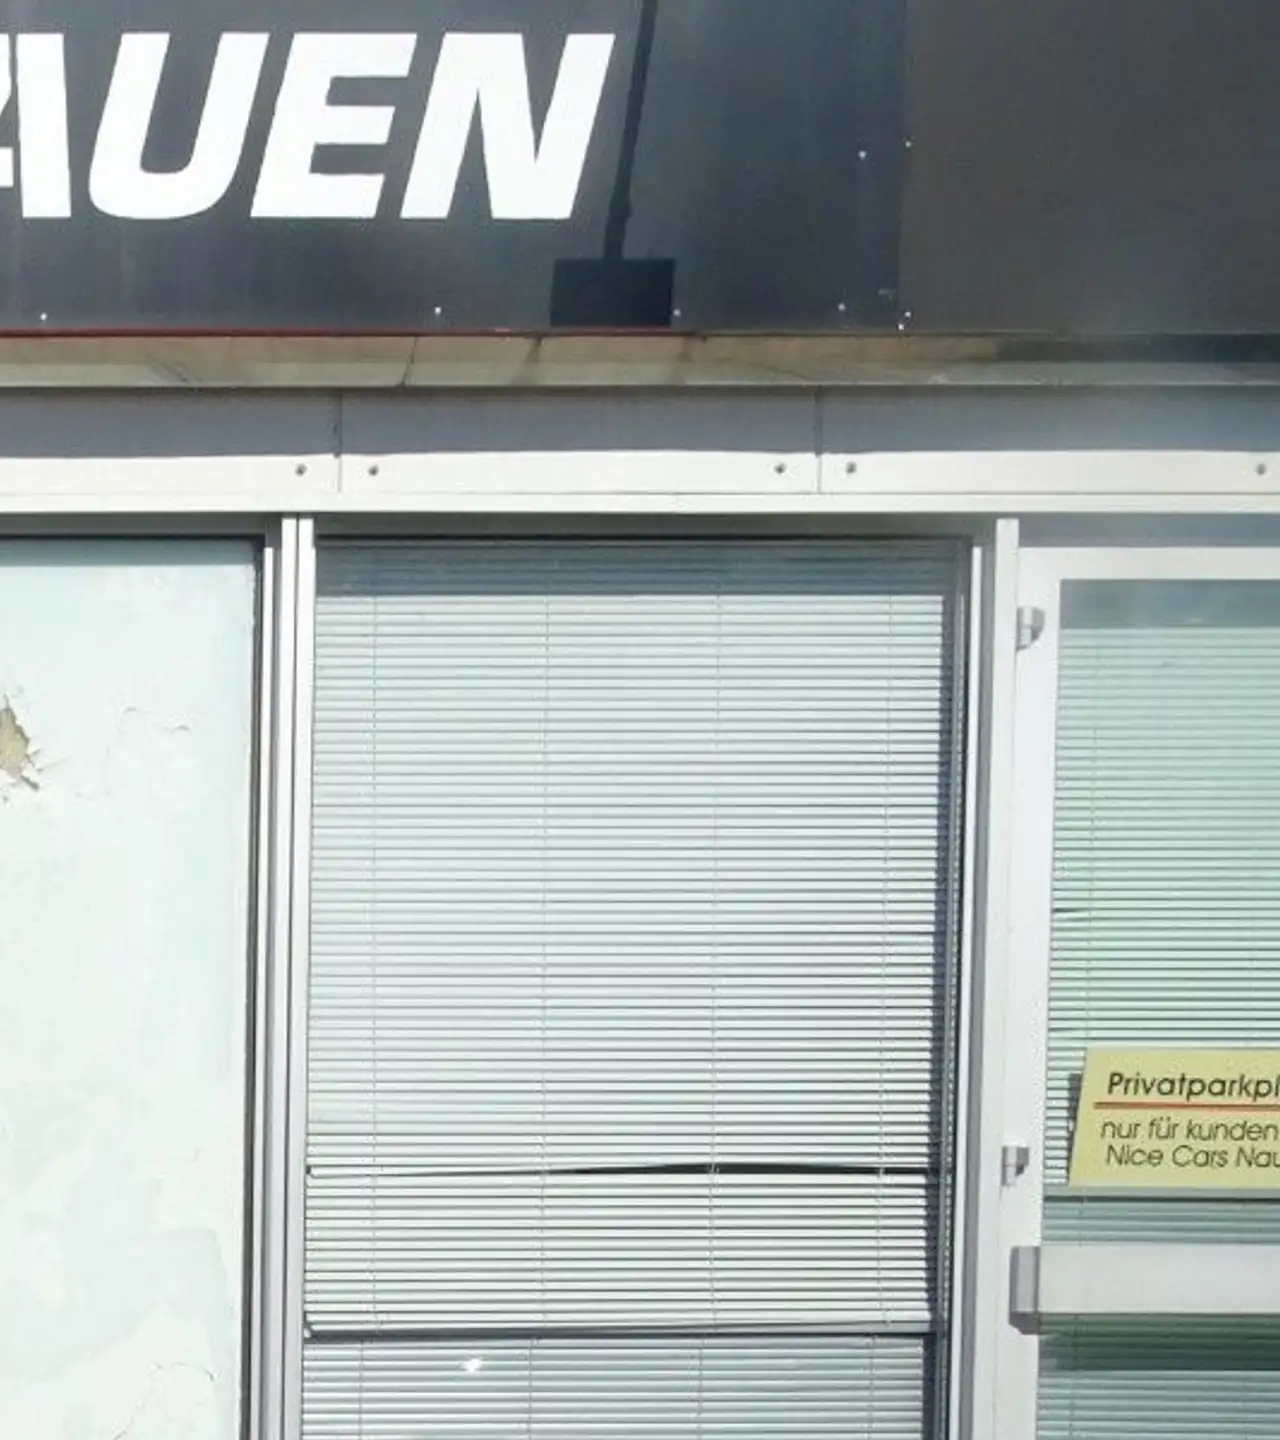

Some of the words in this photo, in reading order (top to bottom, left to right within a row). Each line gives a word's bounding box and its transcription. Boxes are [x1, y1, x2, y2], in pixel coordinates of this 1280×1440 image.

[1100, 1120, 1141, 1140] nur
[1148, 1115, 1180, 1140] für
[1186, 1118, 1280, 1142] kunden
[1106, 1144, 1165, 1167] Nice
[1171, 1144, 1229, 1168] Cars
